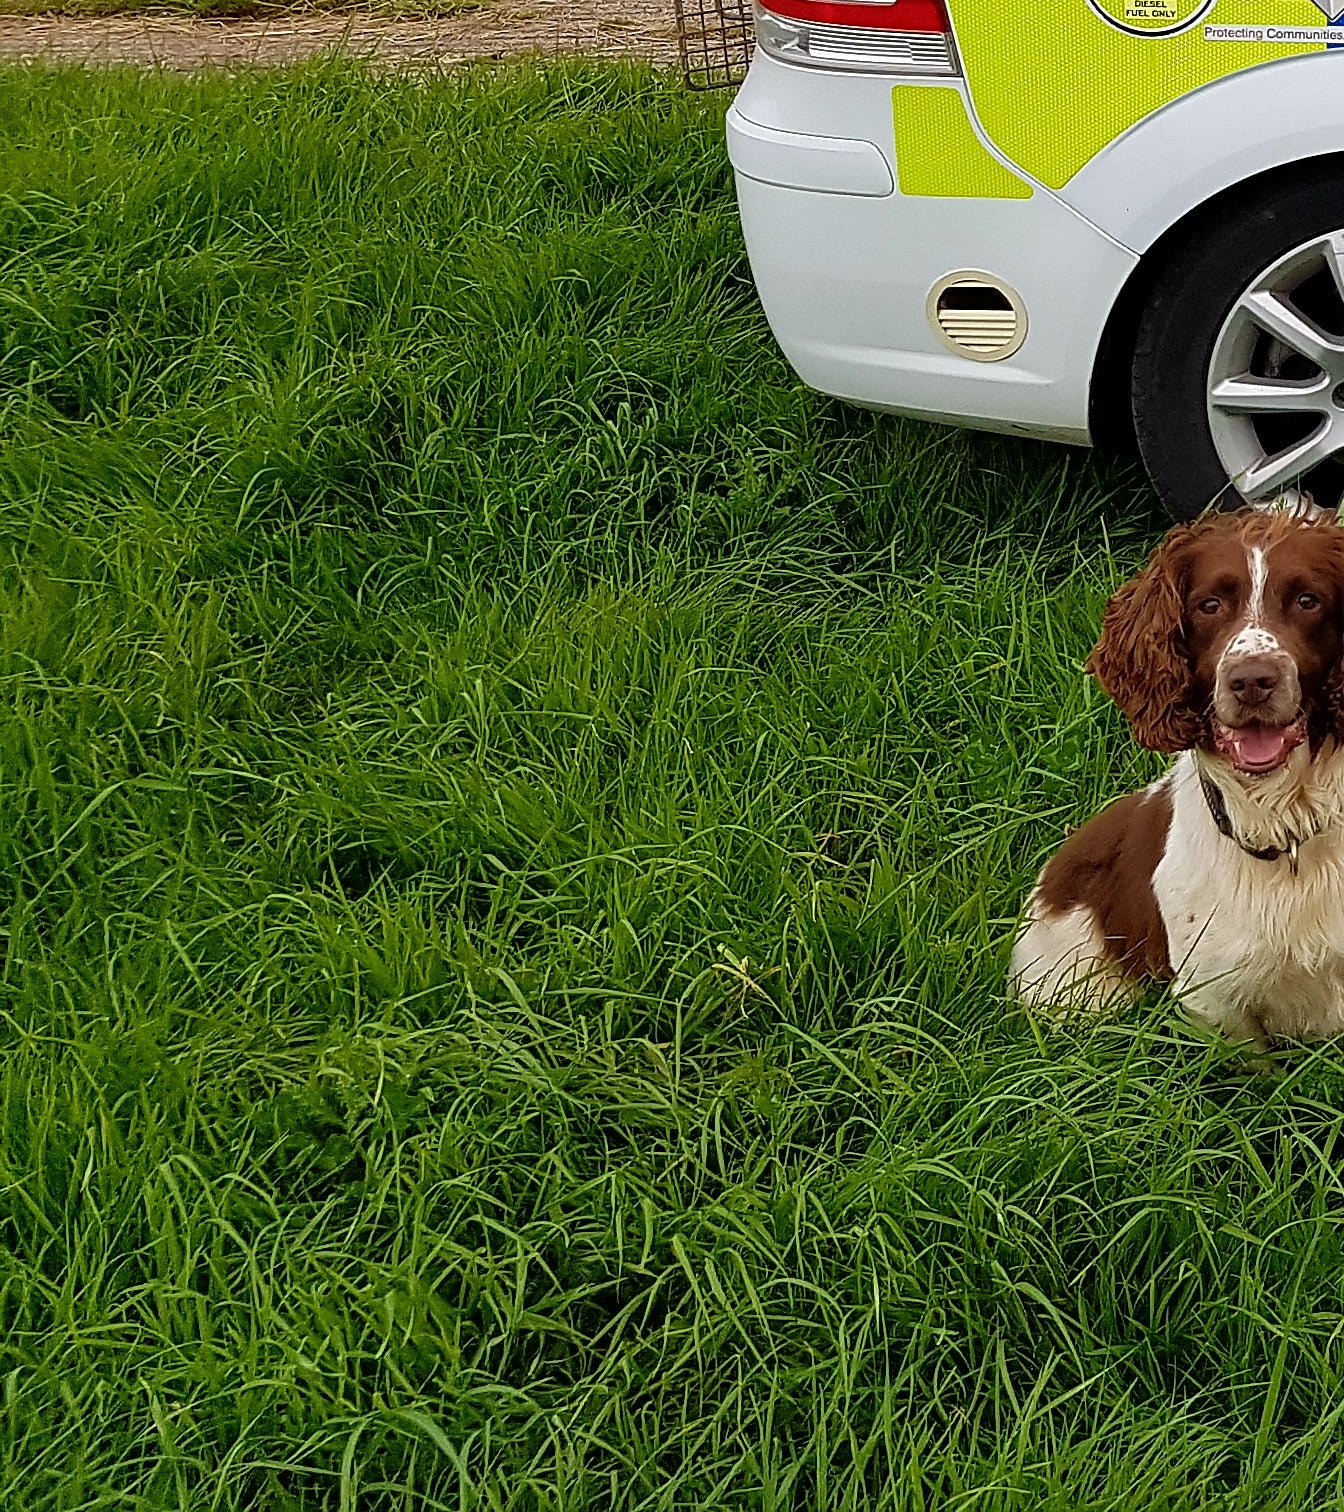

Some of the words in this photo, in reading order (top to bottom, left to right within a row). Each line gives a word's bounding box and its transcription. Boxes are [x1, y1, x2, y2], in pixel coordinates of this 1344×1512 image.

[1134, 0, 1168, 8] DIESEL
[1126, 9, 1150, 17] FUEL
[1151, 10, 1177, 18] ONLY
[1204, 27, 1263, 42] Protecting
